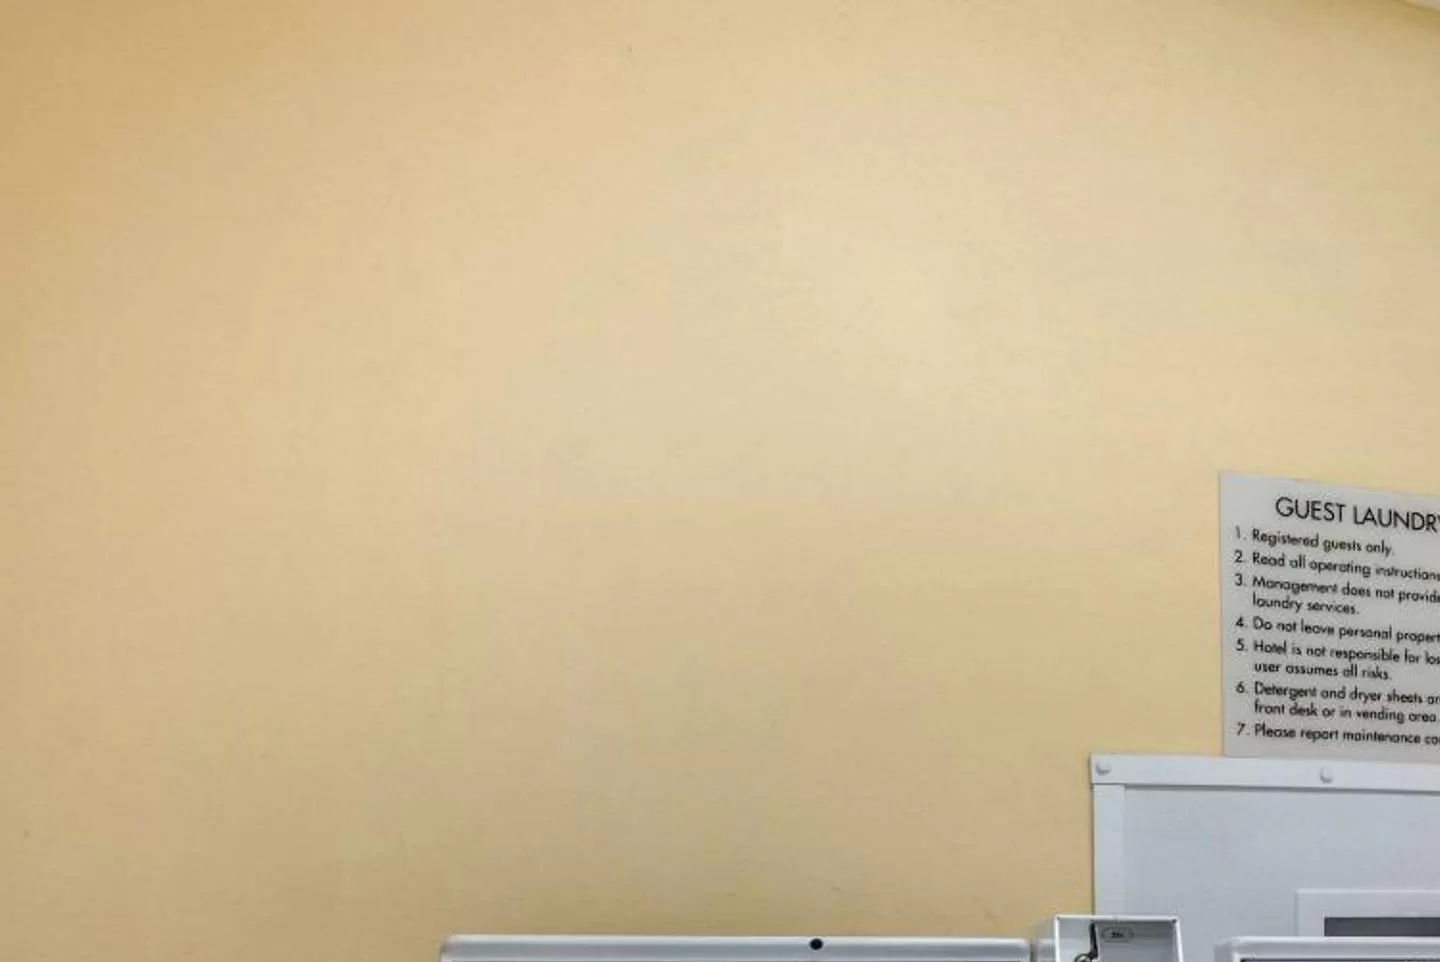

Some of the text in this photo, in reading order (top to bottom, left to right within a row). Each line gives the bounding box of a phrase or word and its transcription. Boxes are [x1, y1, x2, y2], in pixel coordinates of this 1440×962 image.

[1276, 496, 1346, 521] GUEST
[1236, 526, 1395, 556] 1. Registered guests only.
[1235, 551, 1246, 563] 2.
[1253, 552, 1284, 567] Read
[1289, 555, 1305, 568] all
[1309, 561, 1371, 577] operating
[1235, 574, 1246, 586] 3.
[1253, 576, 1337, 594] Management
[1342, 582, 1371, 597] does
[1376, 589, 1394, 598] not
[1253, 592, 1359, 614] laundry services.
[1236, 617, 1247, 628] 4.
[1253, 616, 1272, 631] Do
[1277, 622, 1297, 632] not
[1301, 620, 1334, 635] leave
[1339, 625, 1392, 639] personal
[1236, 639, 1247, 651] 5.
[1254, 640, 1287, 654] Hotel
[1292, 644, 1301, 655] is
[1307, 645, 1325, 656] not
[1330, 649, 1399, 663] responsible
[1405, 649, 1418, 663] for
[1255, 663, 1392, 680] user assumes all risks.
[1236, 681, 1248, 693] 6.
[1255, 681, 1316, 700] Detergent
[1320, 686, 1346, 699] and
[1350, 686, 1382, 704] dryer
[1387, 690, 1422, 704] sheets
[1255, 699, 1440, 724] front desk or in vending area.
[1237, 723, 1249, 736] 7.
[1254, 723, 1296, 738] Please
[1300, 728, 1338, 742] report
[1343, 729, 1421, 744] maintenance
